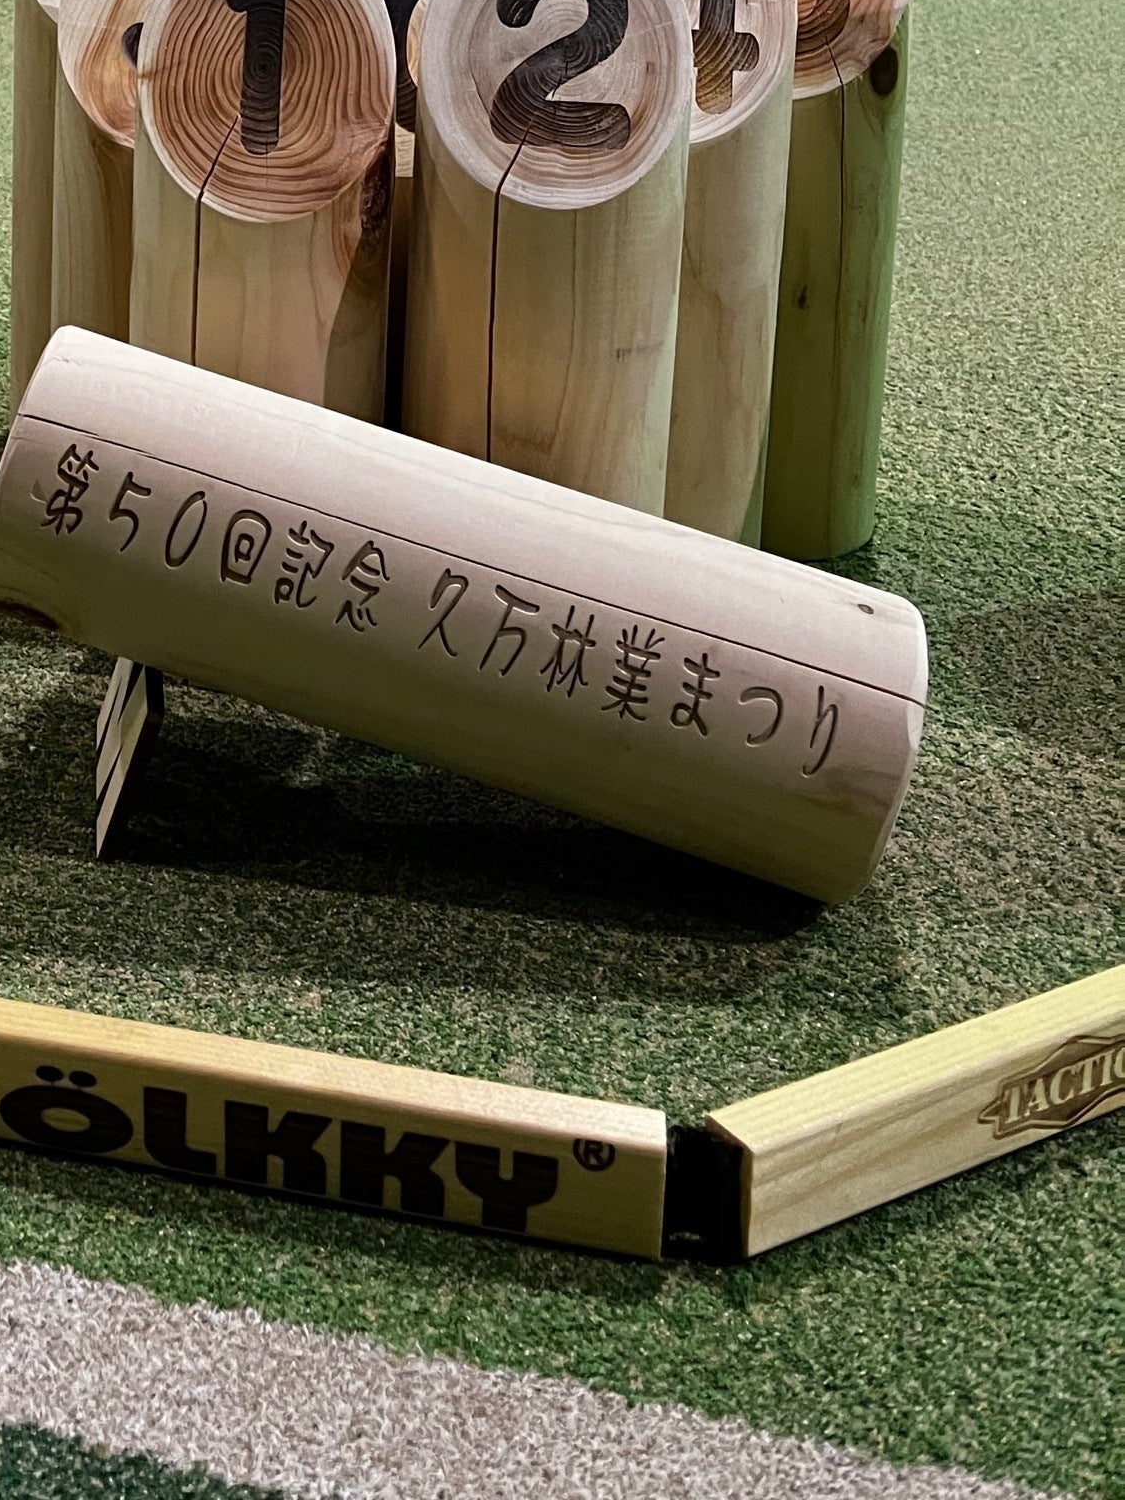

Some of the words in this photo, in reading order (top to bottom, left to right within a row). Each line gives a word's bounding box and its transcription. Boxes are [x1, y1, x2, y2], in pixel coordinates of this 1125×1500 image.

[40, 443, 391, 633] 第50回記念
[417, 567, 839, 778] 久万林業まつり
